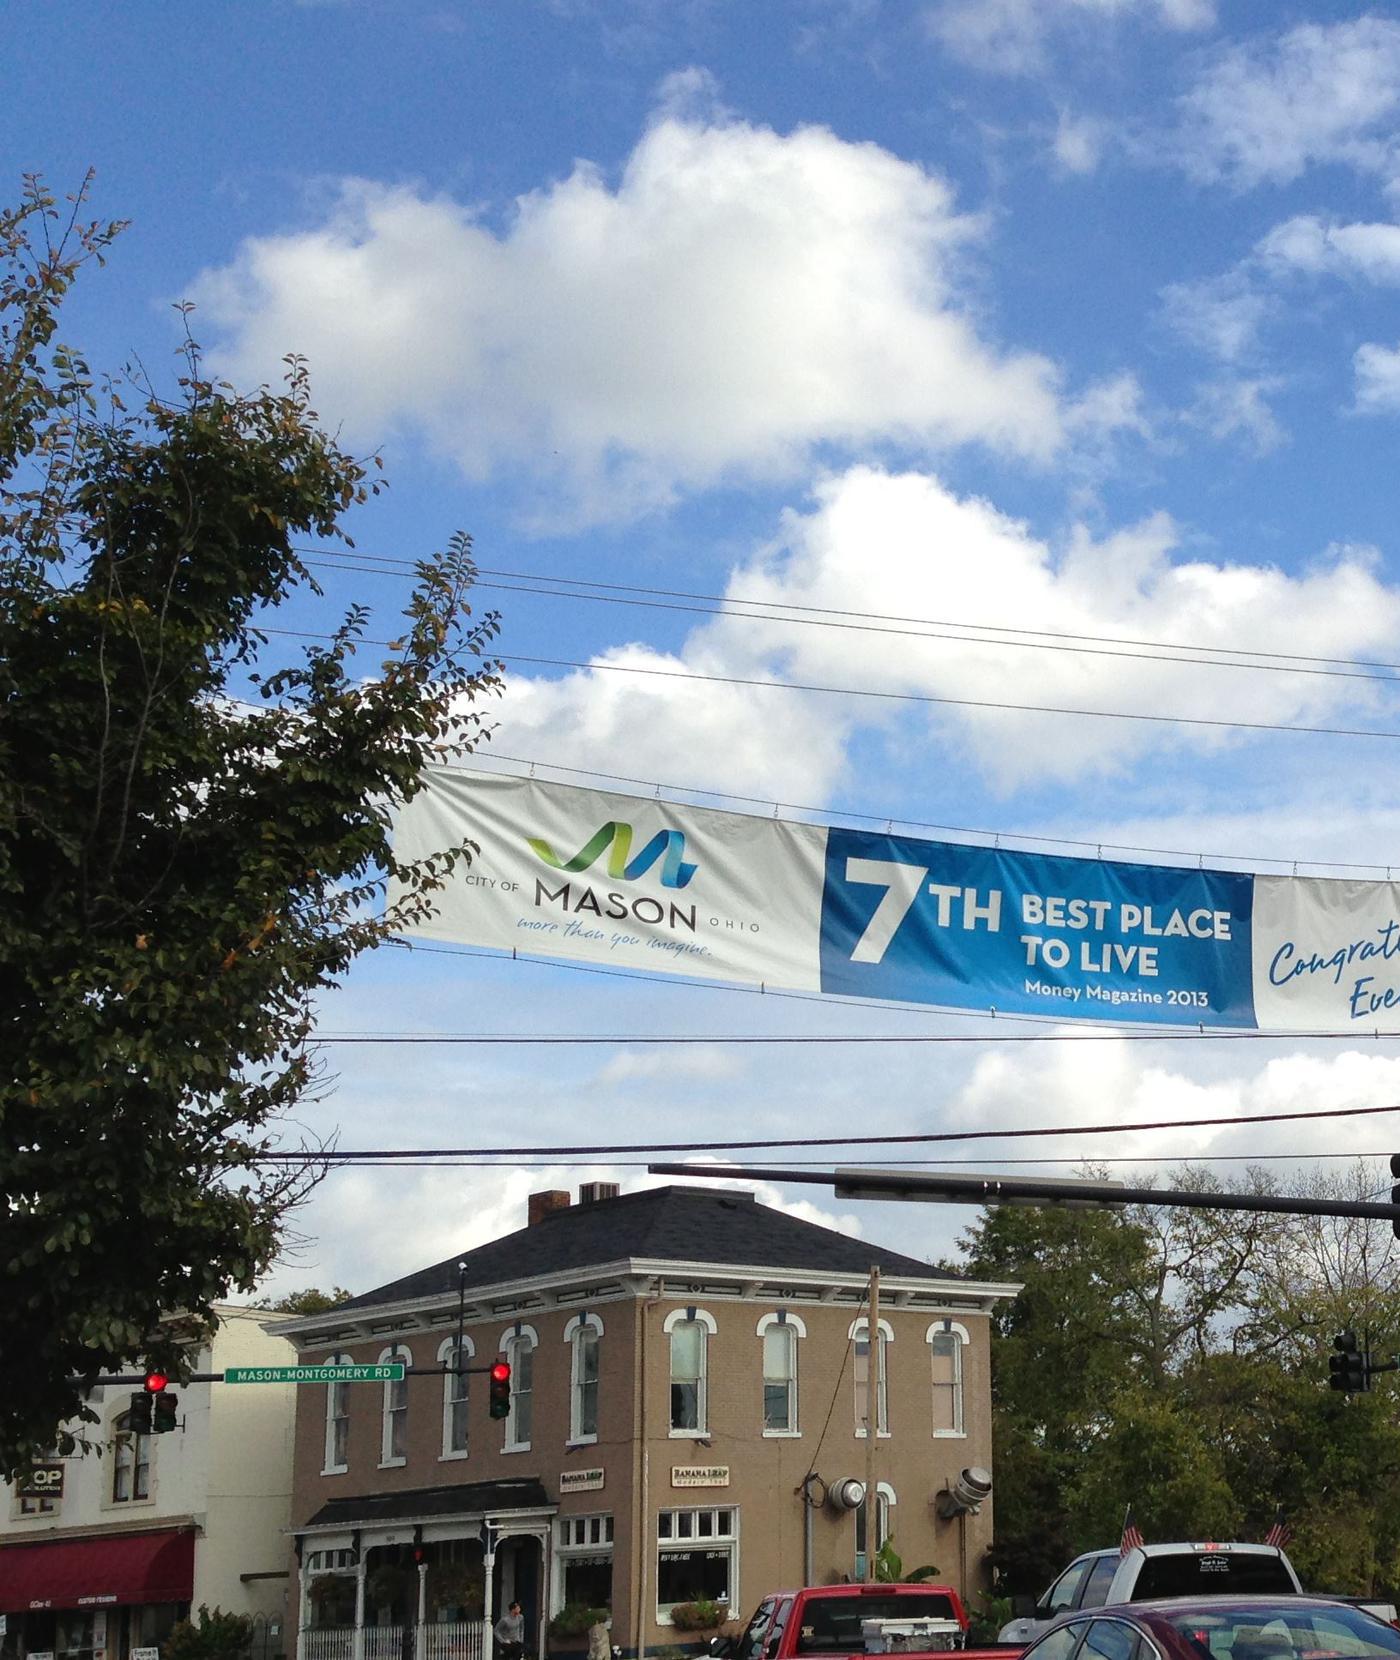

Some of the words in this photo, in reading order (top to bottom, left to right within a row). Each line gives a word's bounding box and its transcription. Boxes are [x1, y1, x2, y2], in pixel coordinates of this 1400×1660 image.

[466, 875, 498, 889] CITY
[501, 880, 520, 892] OF
[535, 877, 696, 932] MASON
[710, 917, 760, 933] OHIO
[845, 857, 1002, 964] 7TH
[1022, 894, 1112, 931] BEST
[1120, 904, 1231, 941] PLACE
[517, 917, 559, 934] more
[562, 920, 605, 941] than
[610, 931, 640, 948] you
[646, 935, 713, 958] imagine.
[1020, 936, 1070, 968] TO
[1080, 942, 1159, 977] LIVE
[1025, 979, 1082, 1002] Money
[1086, 983, 1163, 1006] Magazine
[1166, 990, 1209, 1007] 2013
[237, 1367, 369, 1381] MASON-MONTGOMERY
[374, 1366, 391, 1378] RD
